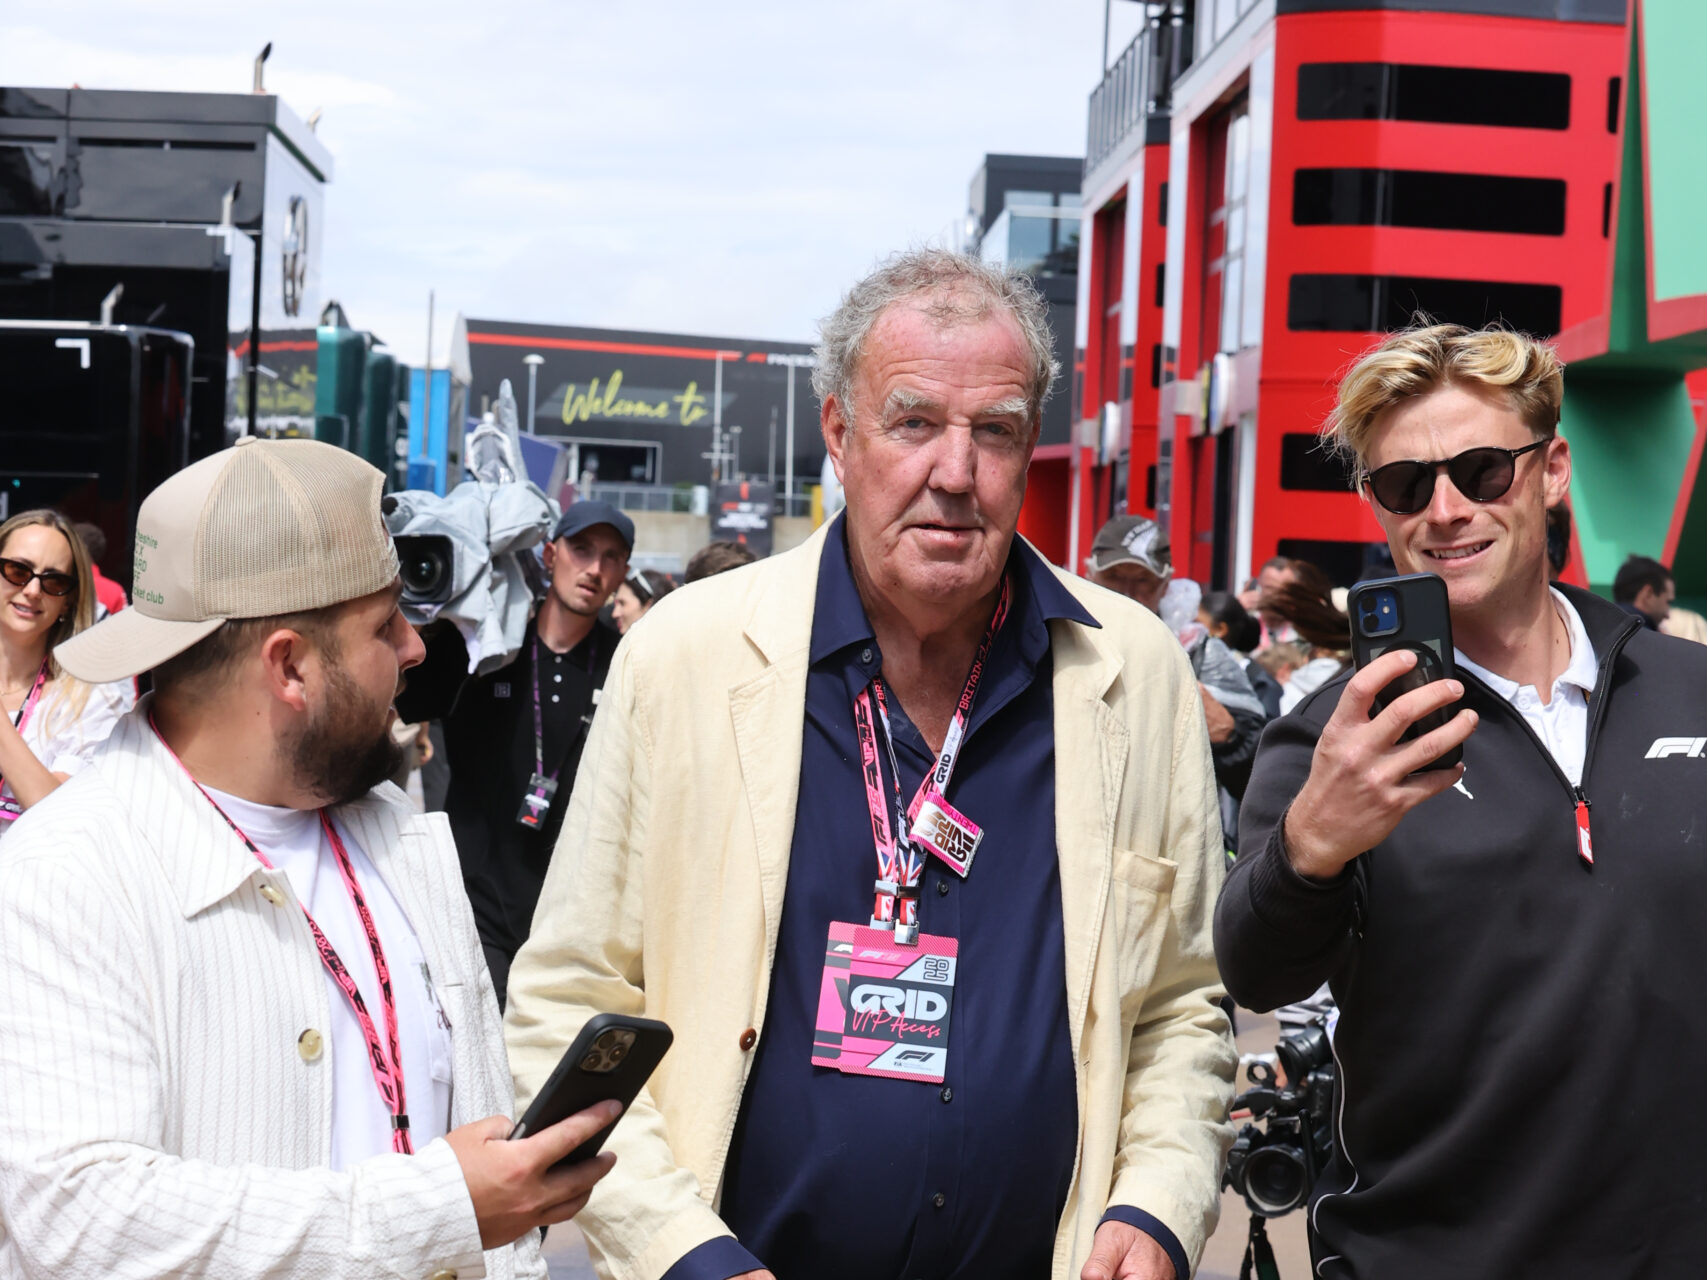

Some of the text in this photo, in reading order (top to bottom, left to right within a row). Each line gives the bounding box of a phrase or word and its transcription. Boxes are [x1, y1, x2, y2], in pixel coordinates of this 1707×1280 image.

[562, 369, 708, 426] Welcome to
[136, 529, 158, 549] heshire
[146, 590, 164, 605] club
[959, 660, 983, 711] BRITAIN
[863, 742, 876, 767] VIP
[1645, 737, 1707, 759] F1
[936, 754, 952, 784] GRID
[934, 831, 968, 863] GRID
[850, 983, 948, 1022] GRID
[852, 1005, 941, 1039] VIP Access
